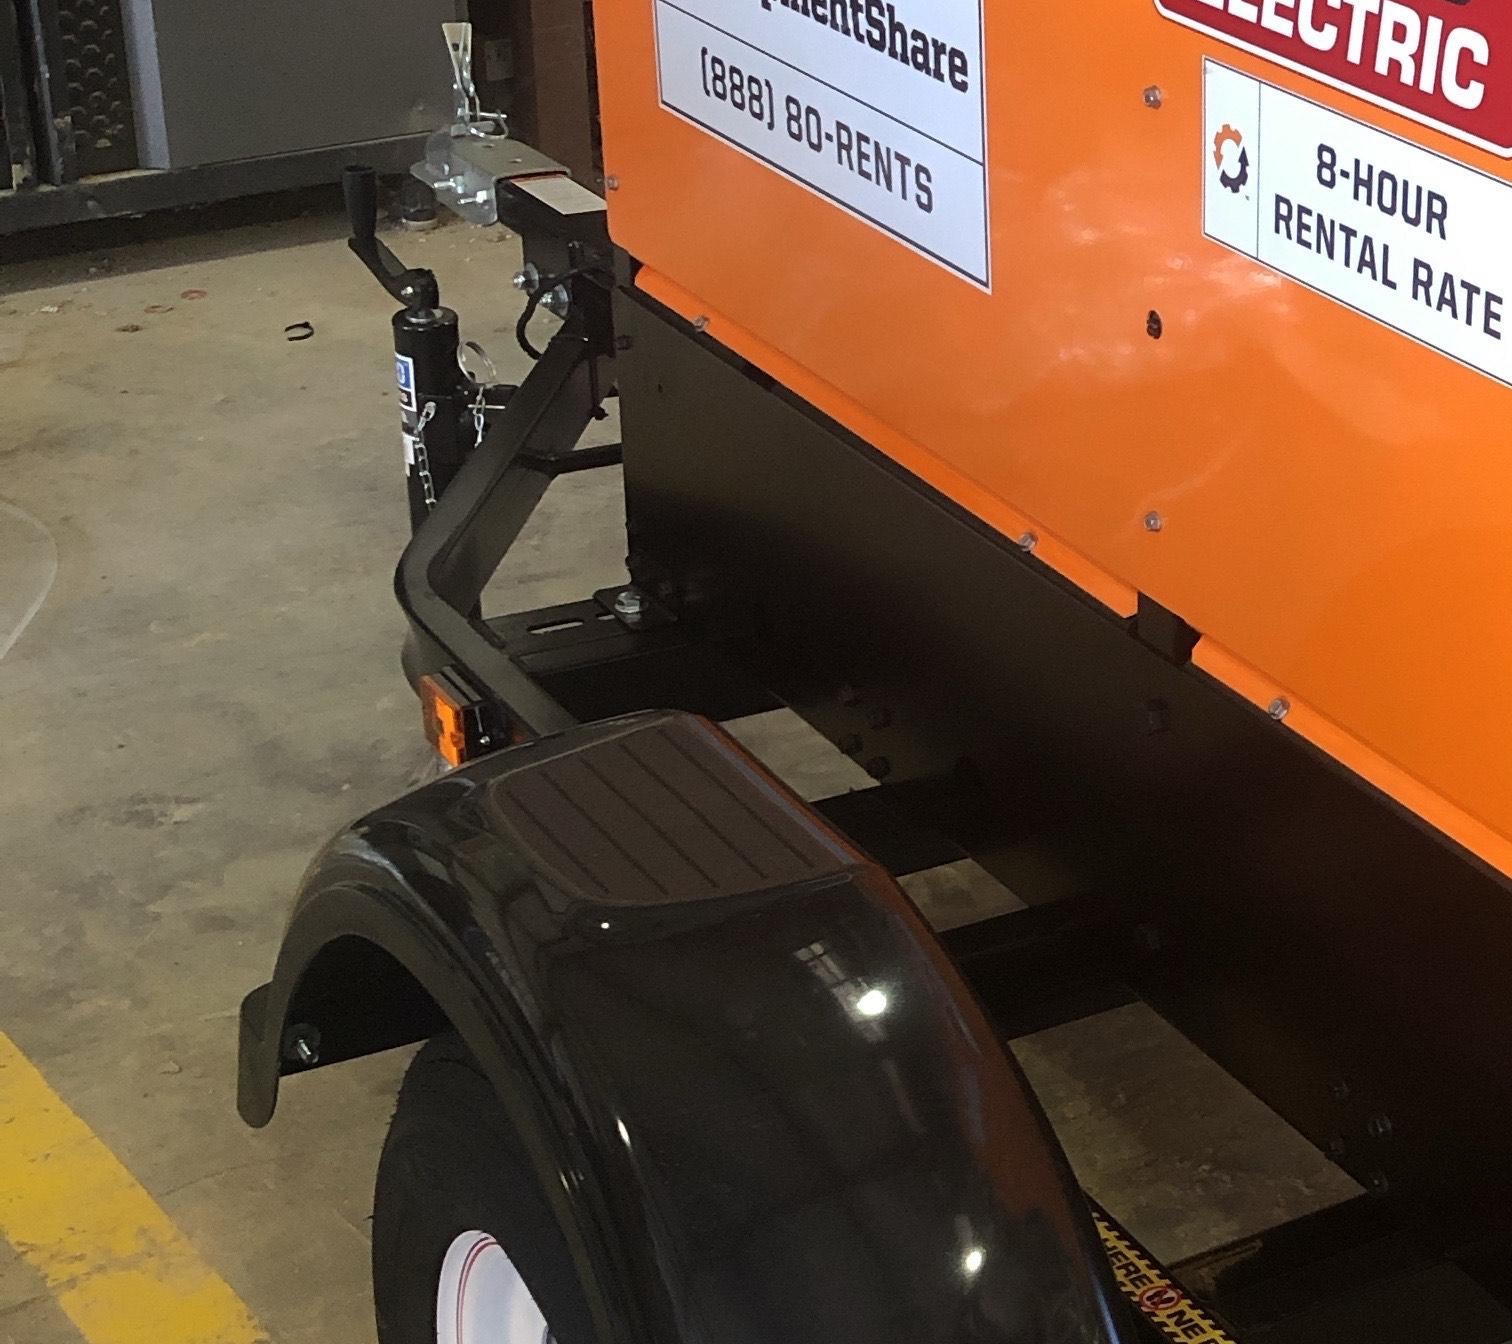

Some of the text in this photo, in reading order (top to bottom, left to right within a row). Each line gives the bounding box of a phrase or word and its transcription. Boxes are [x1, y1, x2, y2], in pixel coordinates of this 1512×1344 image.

[700, 45, 935, 215] (888) 80-RENTS
[1316, 143, 1449, 242] 8-HOUR
[1273, 193, 1504, 340] RENTAL RATE
[1166, 1310, 1209, 1343] NE
